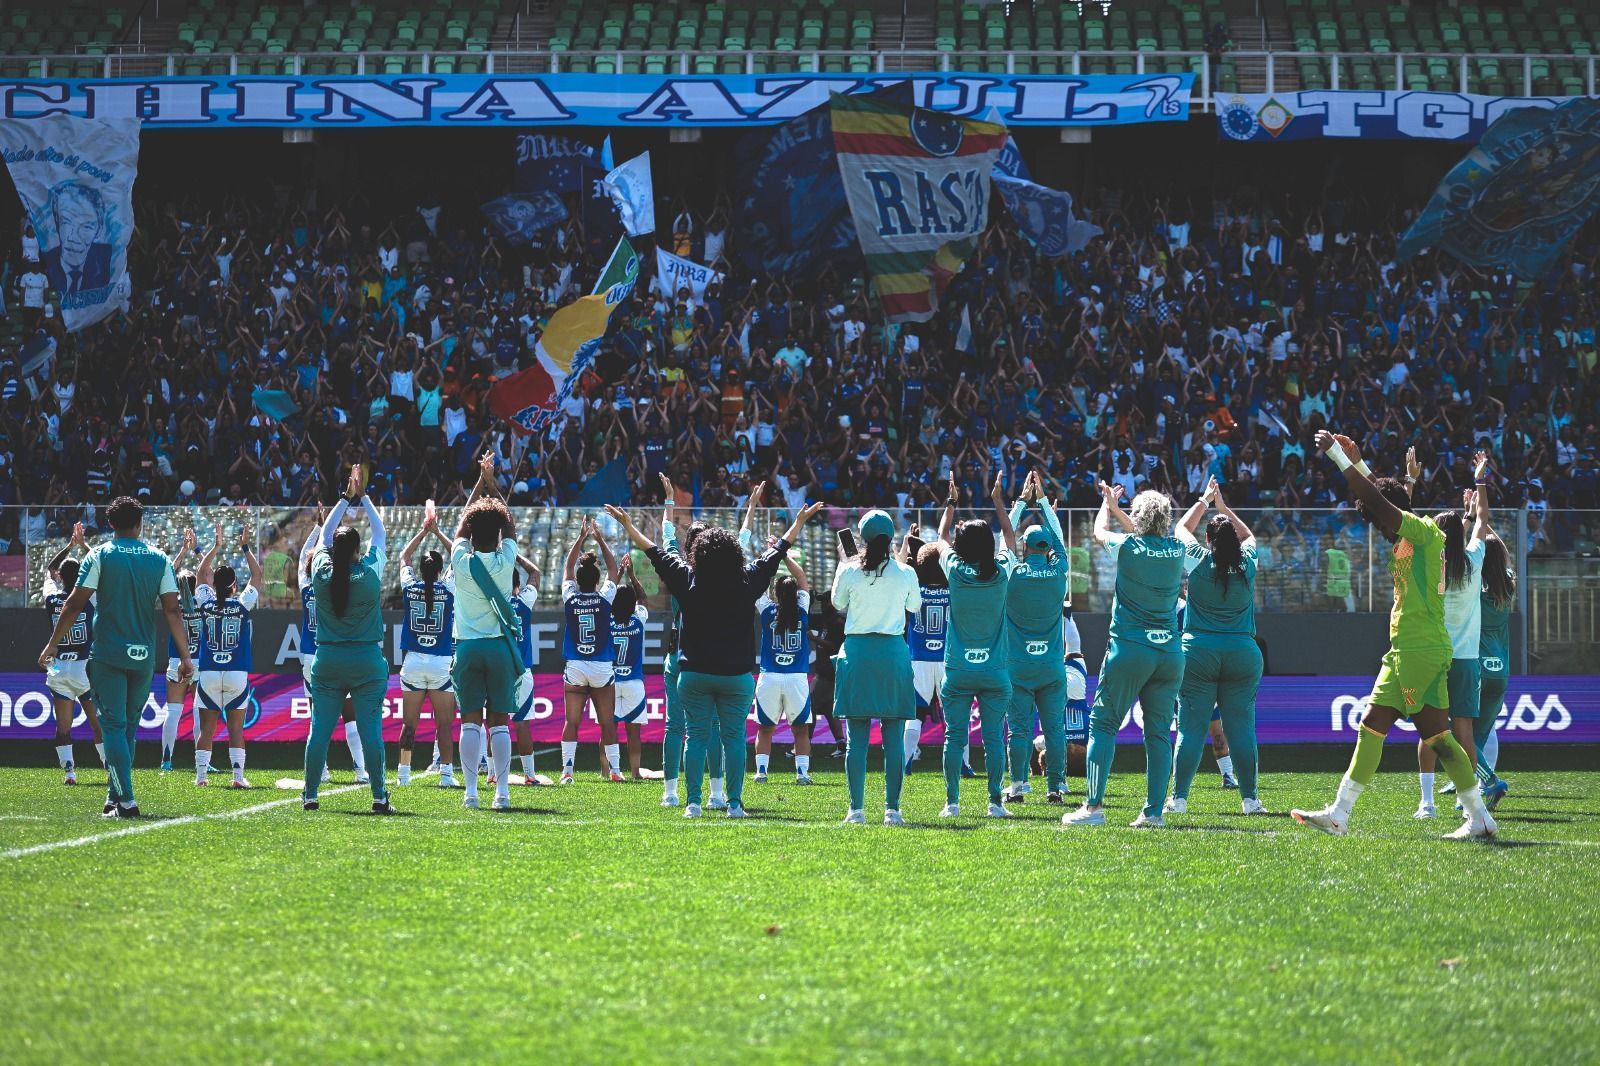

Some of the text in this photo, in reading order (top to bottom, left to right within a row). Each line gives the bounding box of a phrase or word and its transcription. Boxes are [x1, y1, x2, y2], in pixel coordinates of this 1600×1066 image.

[618, 77, 1117, 121] AZUL
[118, 545, 156, 556] betfair
[1147, 547, 1183, 558] betfair
[1026, 568, 1058, 578] betfair
[924, 587, 950, 596] betfai
[578, 613, 596, 643] 2
[205, 616, 242, 652] 18
[419, 637, 435, 645] BH
[129, 648, 147, 657] BH
[613, 636, 629, 665] 7
[1028, 644, 1046, 653] BH
[777, 656, 792, 664] BH
[967, 651, 988, 661] BH
[1486, 660, 1502, 669] BH
